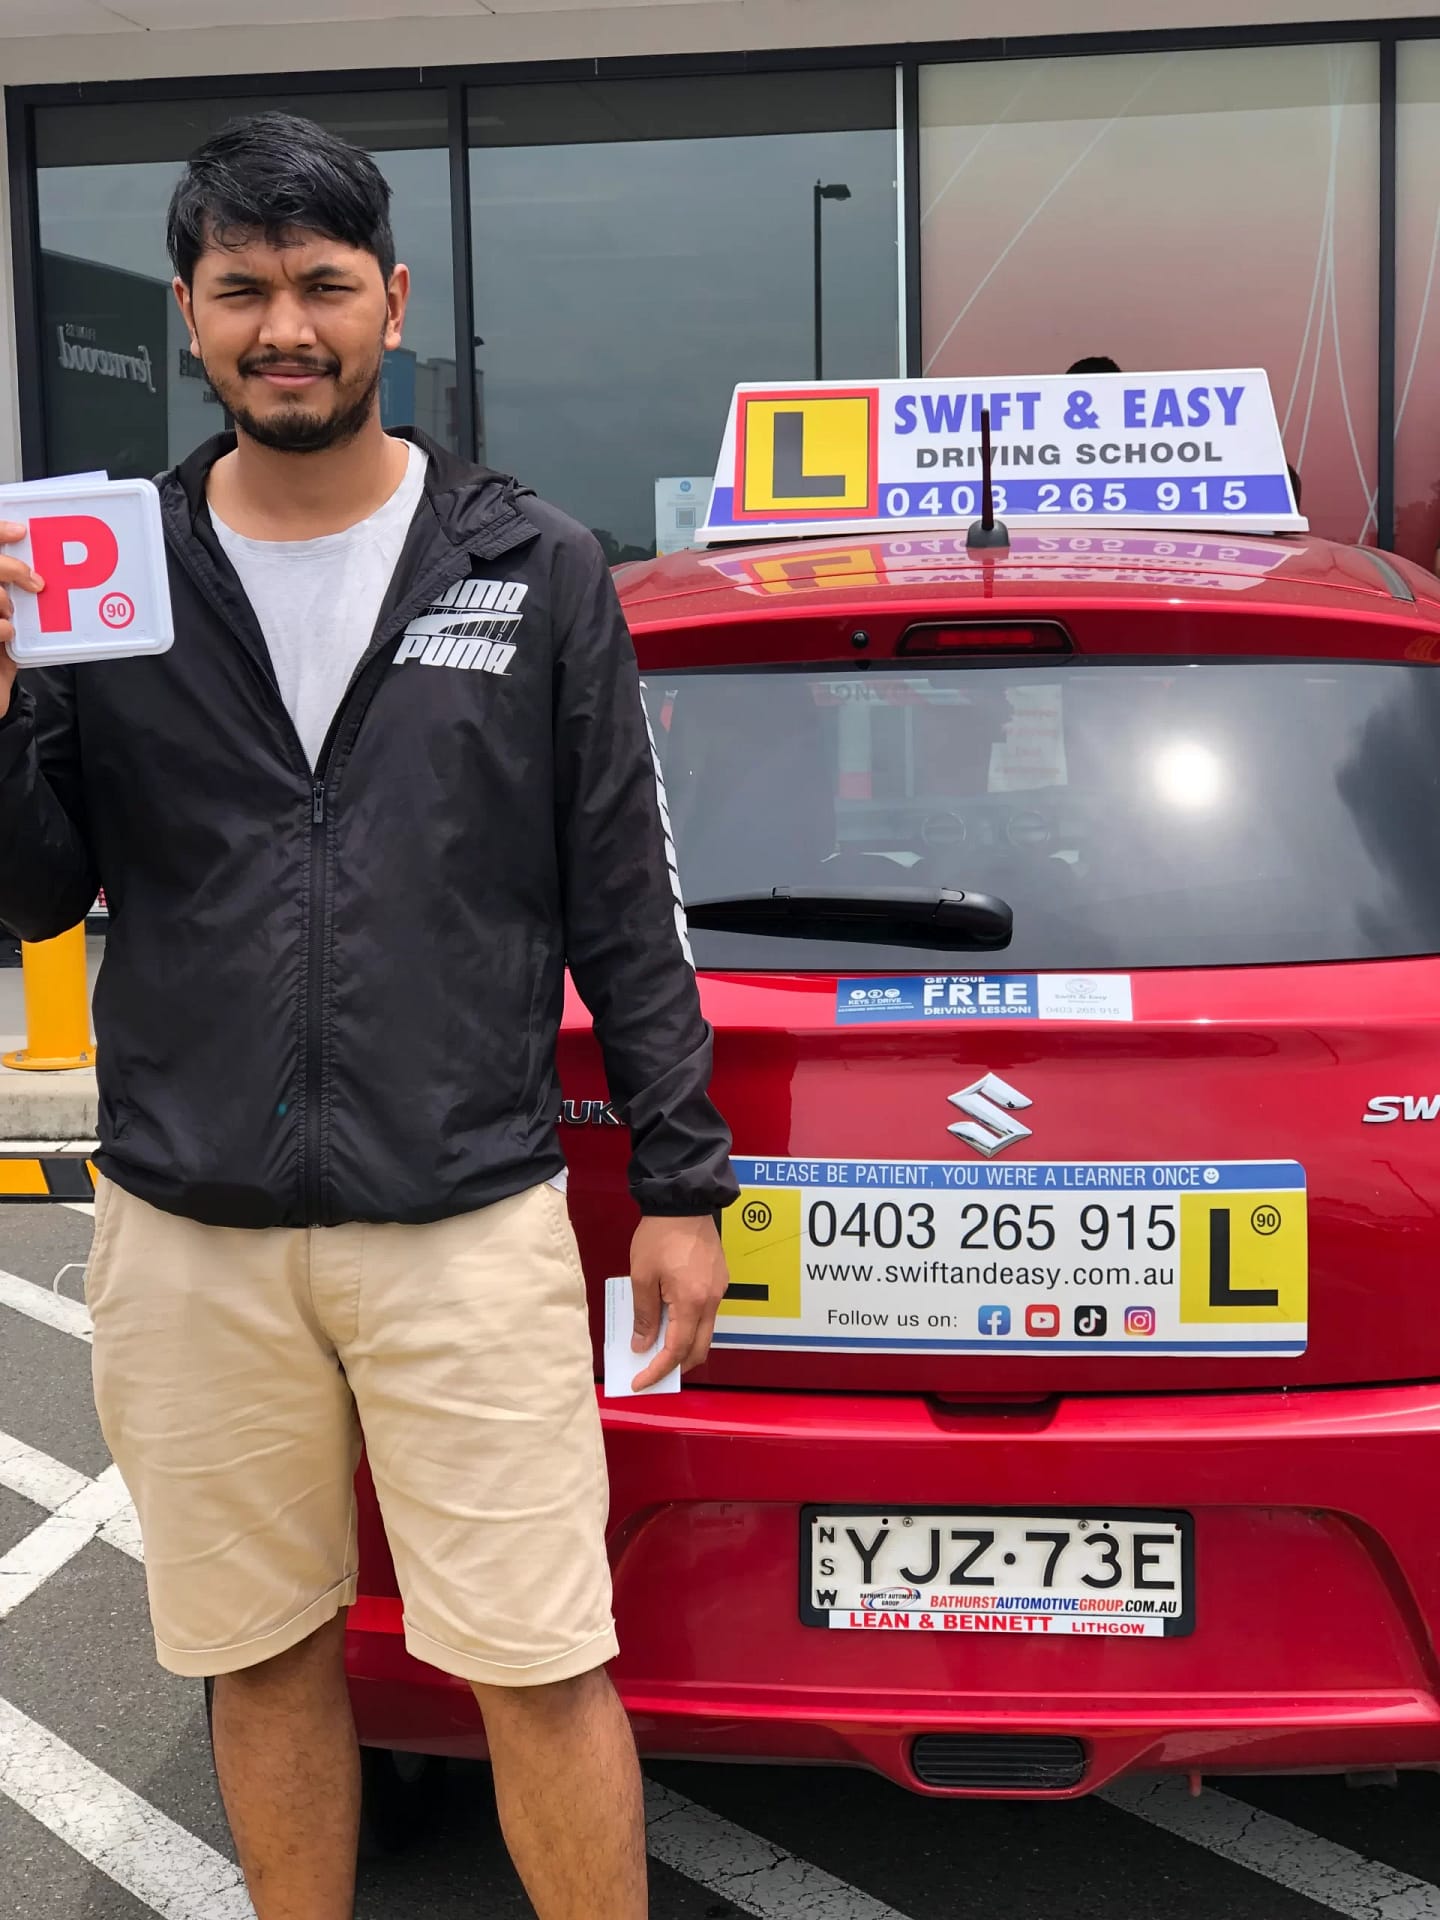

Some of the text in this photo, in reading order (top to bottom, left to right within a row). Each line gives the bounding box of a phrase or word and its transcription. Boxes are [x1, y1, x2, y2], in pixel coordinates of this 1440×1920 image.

[894, 386, 1246, 435] SWIFT & EASY
[772, 411, 846, 499] L
[1075, 441, 1223, 466] SCHOOL
[1037, 482, 1128, 513] 265
[1155, 480, 1248, 511] 915
[29, 515, 119, 633] P
[430, 579, 529, 612] UMA
[106, 603, 126, 618] 90
[392, 635, 517, 675] PUMA
[925, 976, 985, 984] GET YOUR
[924, 983, 1027, 1007] FREE
[924, 1005, 977, 1015] DRIVING
[981, 1004, 1031, 1014] LESSON!
[754, 1162, 1200, 1187] PLEASE BE PATIENT, YOU WERE A LEARNER ONCE
[747, 1209, 767, 1225] 90
[808, 1200, 1176, 1251] 0403 265 915
[1256, 1212, 1276, 1229] 90
[1209, 1208, 1279, 1307] L
[806, 1260, 1174, 1290] www.swiftandeasy.com.au
[828, 1309, 958, 1328] Follow us on:
[929, 1594, 1177, 1614] BATHURSTAUTOMOTIVEGROUP.COM.AU
[849, 1612, 1054, 1632] LEAN & BENNETT
[1071, 1622, 1145, 1635] LITHGOW
